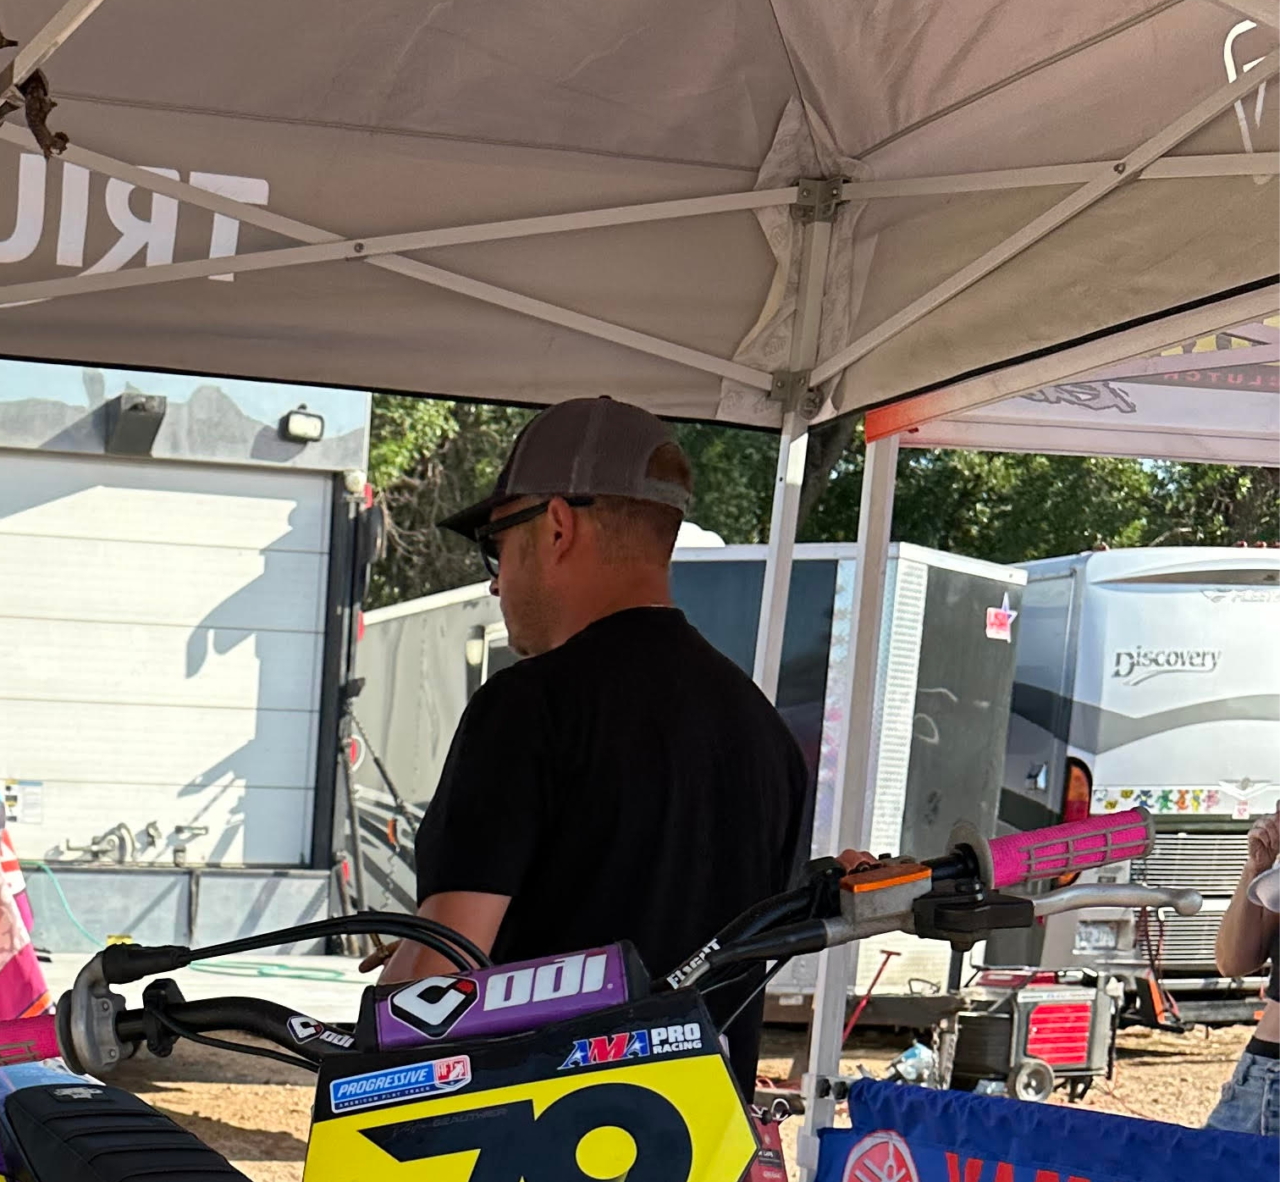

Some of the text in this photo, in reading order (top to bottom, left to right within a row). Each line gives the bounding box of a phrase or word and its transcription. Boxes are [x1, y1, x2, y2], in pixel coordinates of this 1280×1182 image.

[1111, 645, 1222, 678] Discovery
[557, 1023, 701, 1070] AMA PRO
[652, 1040, 702, 1054] RACING
[337, 1068, 428, 1097] PROGRESSIVE
